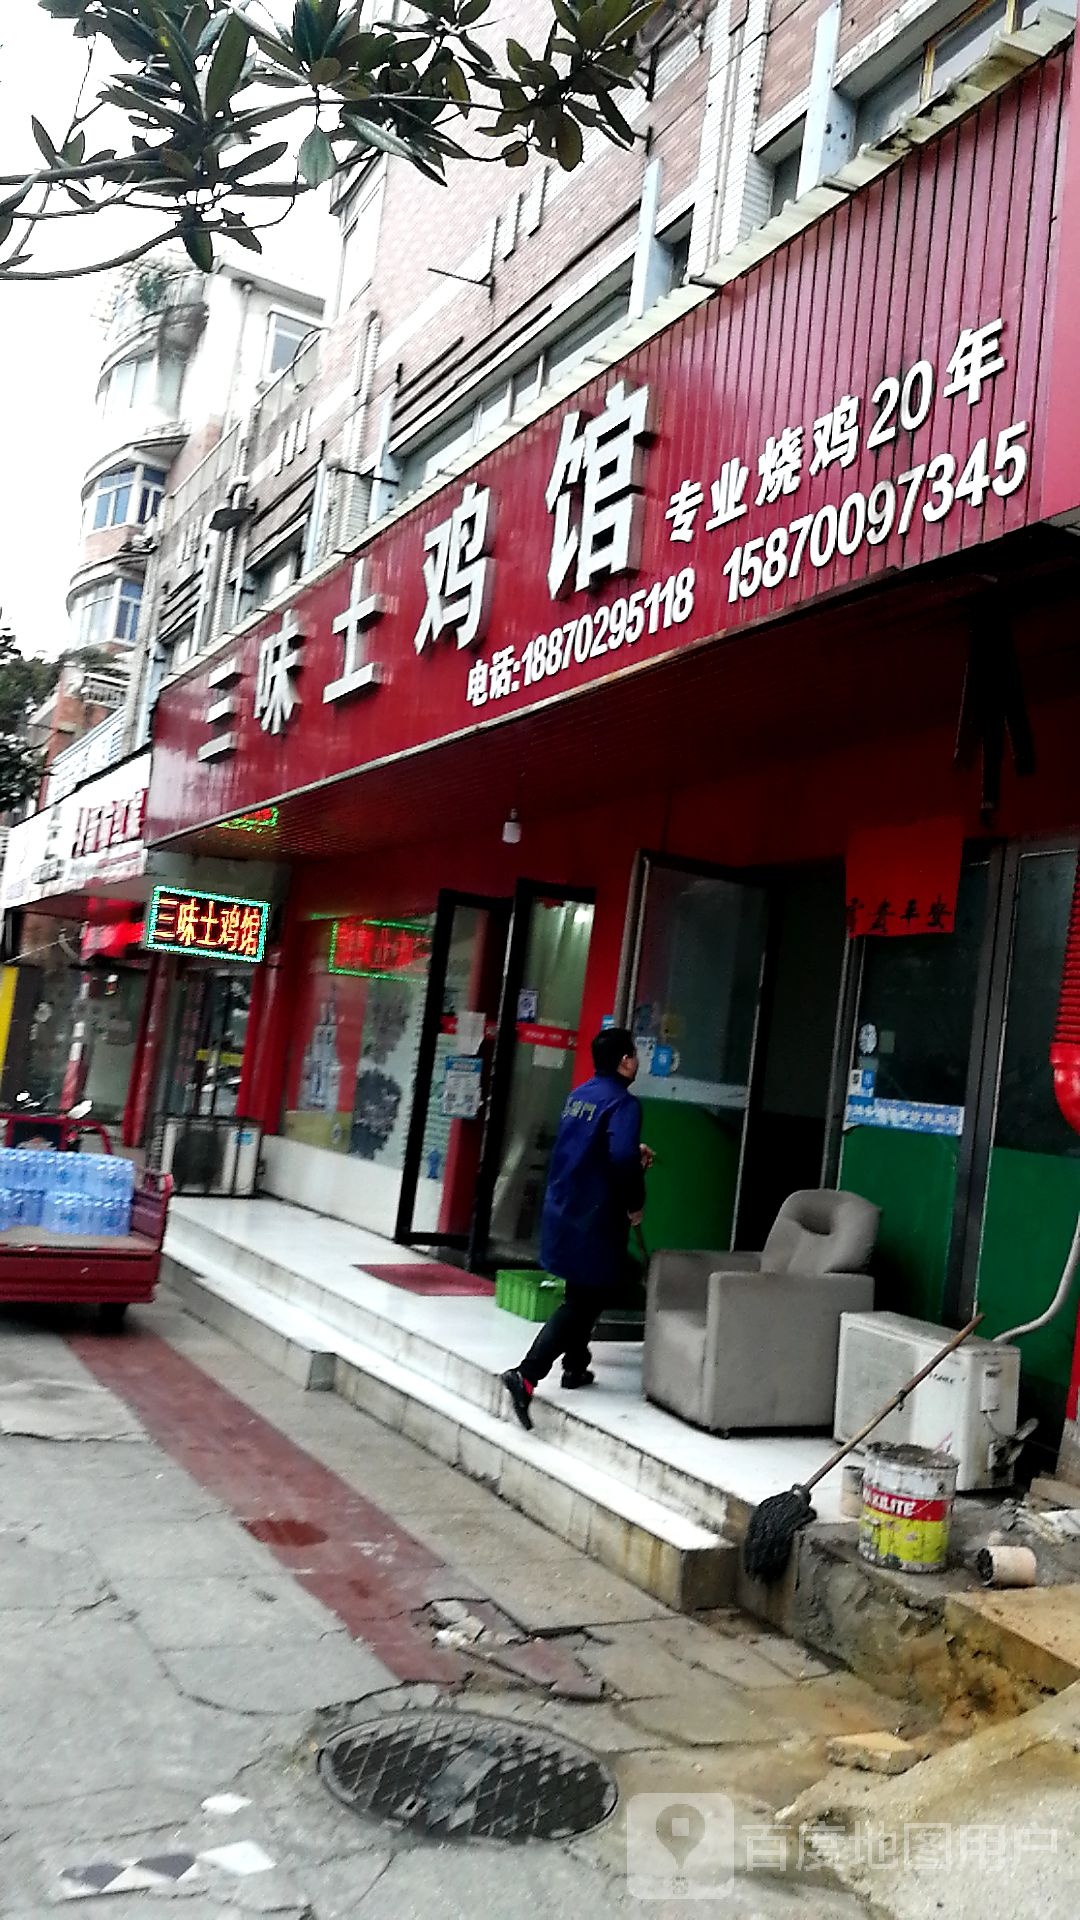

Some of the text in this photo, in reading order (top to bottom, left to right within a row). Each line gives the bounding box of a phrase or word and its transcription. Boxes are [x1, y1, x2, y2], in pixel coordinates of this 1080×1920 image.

[664, 319, 1006, 544] 专业烧鸡20年
[722, 420, 1028, 603] 15870097345
[197, 379, 650, 763] 三味土鸡馆
[156, 897, 260, 956] 三味土鸡馆
